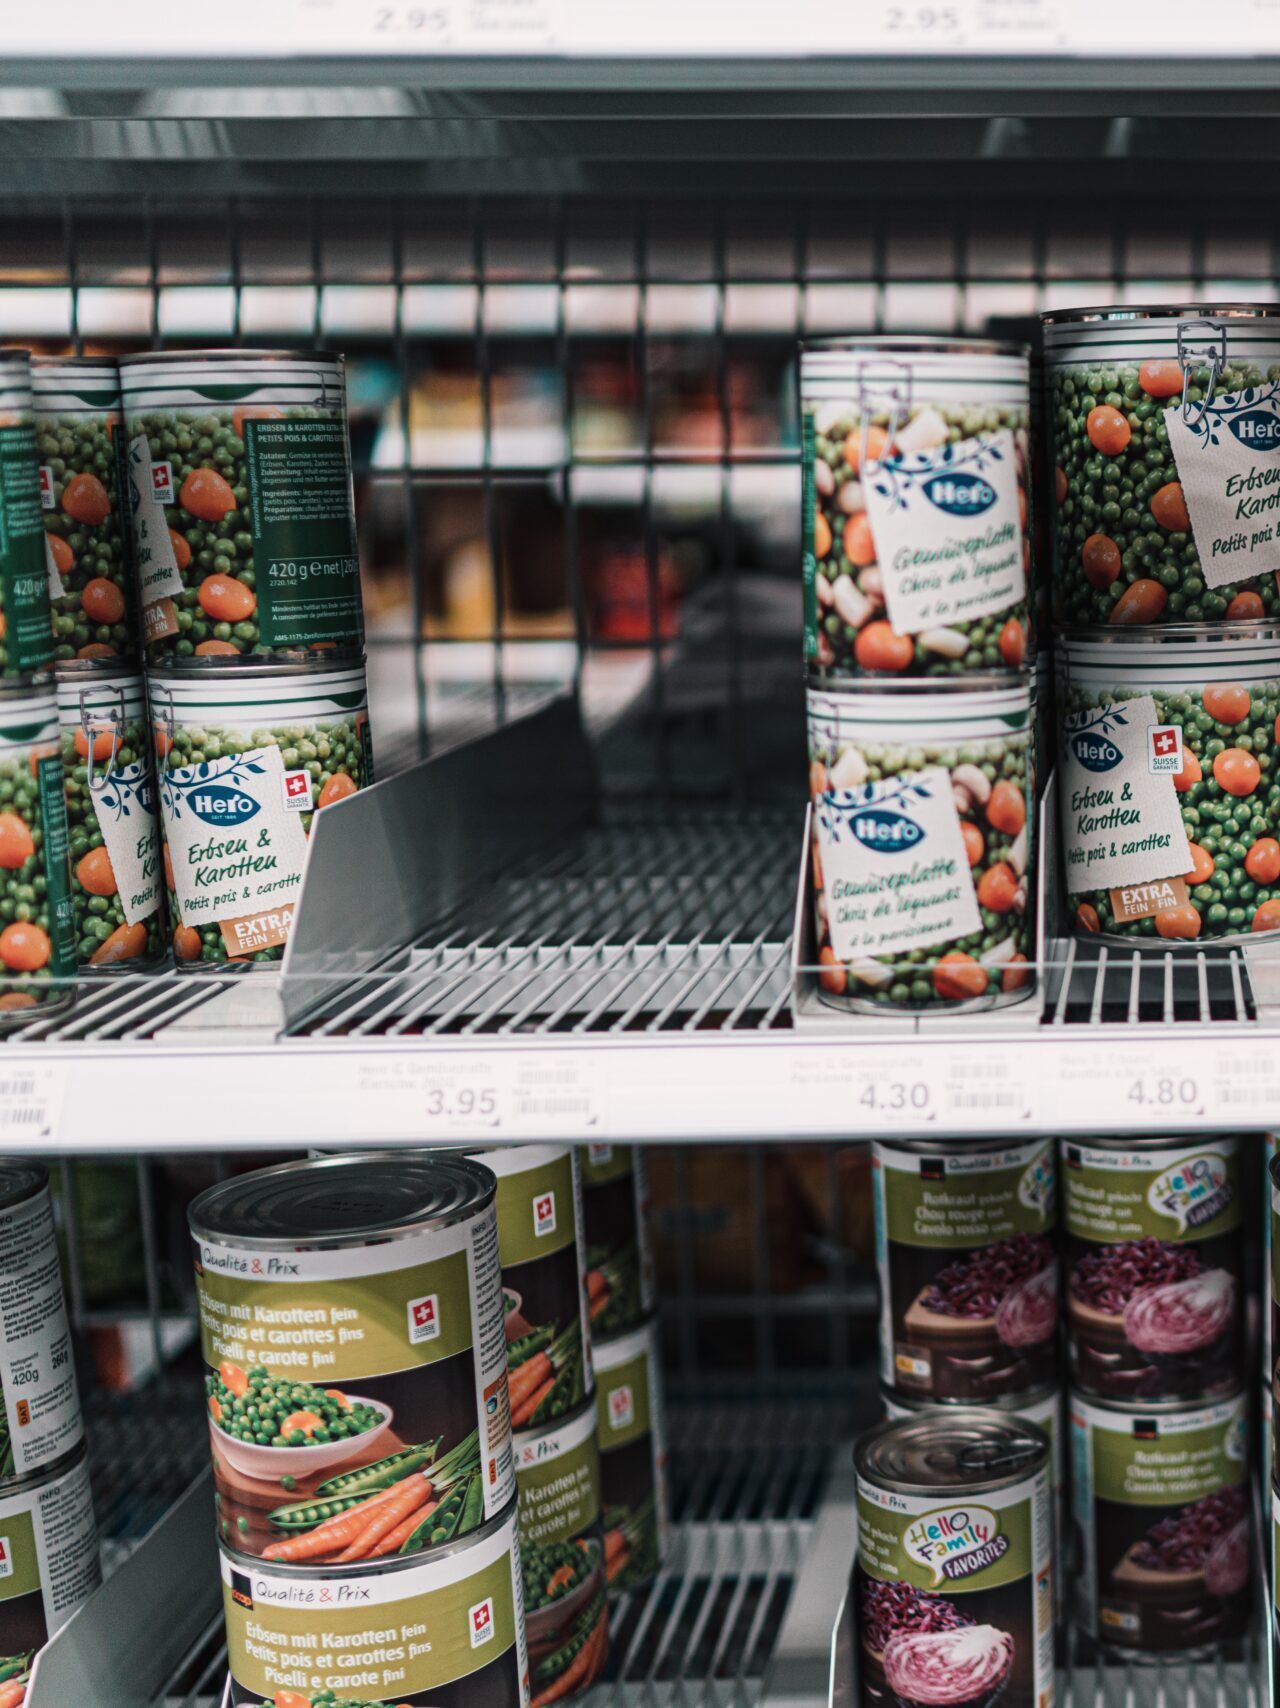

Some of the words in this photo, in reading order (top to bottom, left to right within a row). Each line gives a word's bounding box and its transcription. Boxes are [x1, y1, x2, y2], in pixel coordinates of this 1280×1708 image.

[257, 424, 286, 432] ERBSEN
[258, 434, 282, 442] PETITS
[284, 434, 300, 442] POIS
[931, 480, 993, 504] Hero
[1225, 466, 1280, 498] Erbsen
[1212, 531, 1248, 557] Petits
[1251, 525, 1273, 552] pois
[268, 563, 296, 578] 420
[324, 561, 340, 575] net
[269, 579, 298, 587] 2720.142
[1077, 741, 1117, 761] Hero
[1153, 757, 1179, 765] SUISSE
[195, 794, 253, 814] Hero
[1071, 784, 1113, 812] Erbsen
[1121, 782, 1133, 801] &
[856, 818, 919, 841] Hero
[1077, 807, 1141, 835] Karotten
[188, 837, 248, 865] Erbsen
[257, 828, 272, 848] &
[1109, 843, 1117, 857] &
[1121, 833, 1172, 857] carottes
[194, 853, 278, 888] Karotten
[184, 895, 209, 912] Petits
[213, 892, 237, 910] pois
[242, 886, 251, 899] &
[1121, 882, 1175, 905] EXTRA
[1124, 902, 1149, 915] FEIN
[1158, 895, 1177, 909] FIN
[234, 911, 294, 939] EXTRA
[238, 933, 267, 950] FEIN
[427, 1089, 496, 1116] 3.95
[859, 1083, 930, 1109] 4.30
[1127, 1079, 1198, 1105] 4.80
[203, 1248, 248, 1274] Qualité
[251, 1259, 264, 1275] &
[267, 1259, 300, 1276] Prix
[230, 1303, 251, 1321] mit
[254, 1305, 327, 1324] Karotten
[223, 1321, 248, 1341] pois
[267, 1327, 335, 1345] carottes
[413, 1323, 436, 1335] SUISSE
[212, 1335, 245, 1362] Piselli
[247, 1349, 256, 1363] e
[258, 1348, 308, 1366] carote
[13, 1369, 39, 1387] 420g
[39, 1487, 60, 1503] INFO
[256, 1580, 315, 1602] Qualité
[319, 1586, 334, 1602] &
[337, 1585, 370, 1601] Prix
[245, 1621, 289, 1647] Erbsen
[290, 1632, 317, 1649] mit
[321, 1626, 397, 1649] Karotten
[399, 1622, 427, 1642] fein
[474, 1627, 492, 1641] SUISSE
[245, 1640, 278, 1664] Petits
[279, 1650, 312, 1670] pois
[315, 1651, 332, 1669] et
[336, 1646, 405, 1669] carottes
[407, 1641, 432, 1660] fins
[264, 1666, 307, 1689] Piselli
[310, 1674, 321, 1688] e
[325, 1670, 379, 1689] carote
